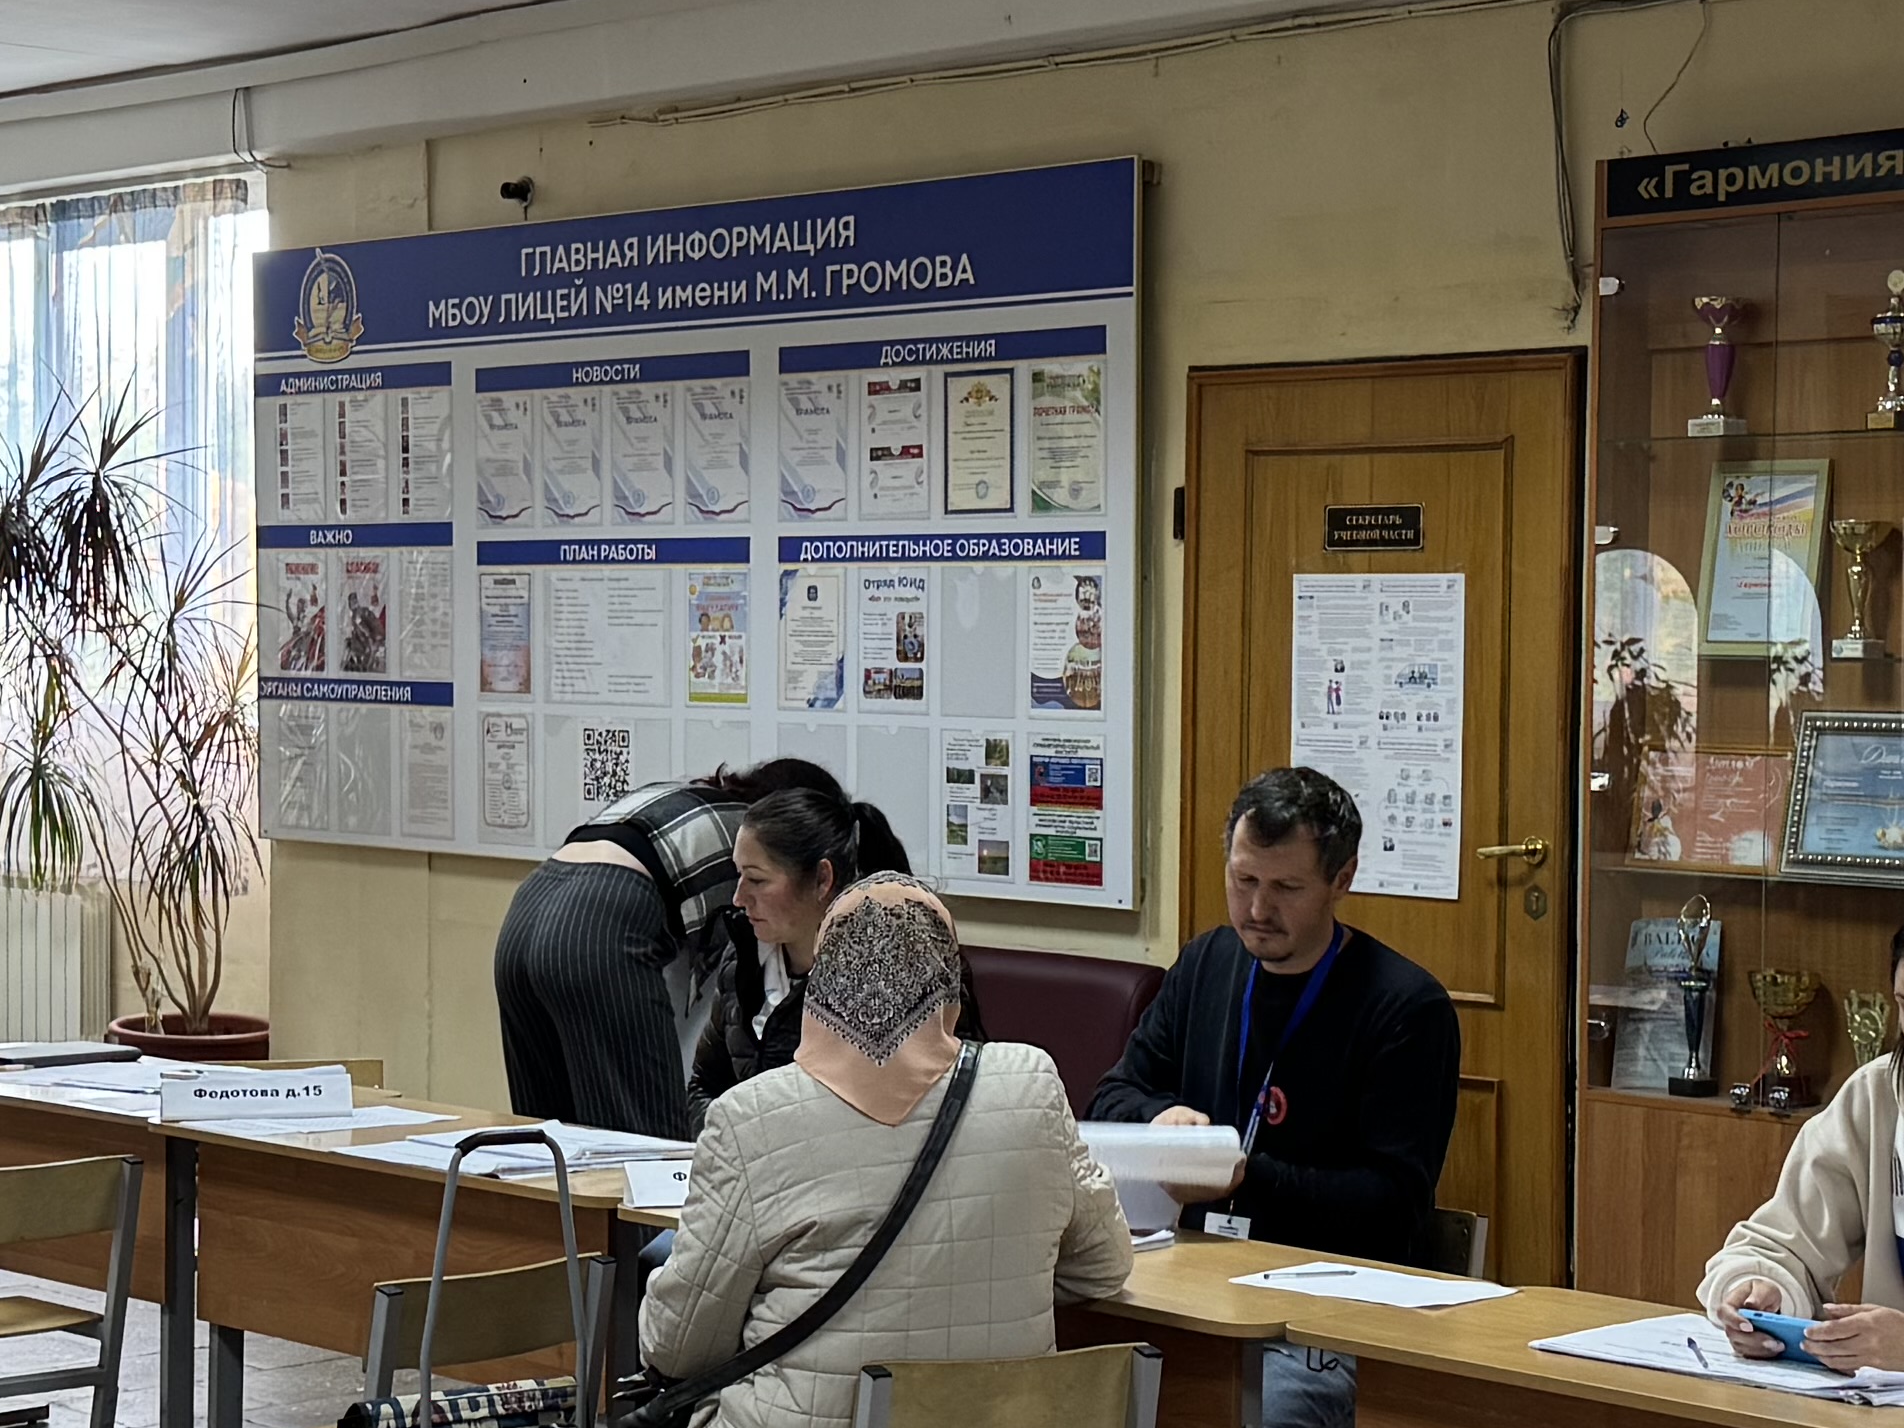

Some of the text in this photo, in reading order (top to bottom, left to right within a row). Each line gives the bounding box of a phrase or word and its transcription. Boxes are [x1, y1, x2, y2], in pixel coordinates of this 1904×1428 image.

[521, 215, 855, 277] ГЛАВНАЯ ИНФОРМАЦИЯ
[428, 253, 975, 328] МБОУ ЛИЦЕЙ №14 имени М.М. ГРОМОВА
[880, 339, 996, 367] ДОСТИЖЕНИЯ
[280, 372, 382, 394] АДМИНИСТРАЦИЯ
[572, 364, 640, 384] НОВОСТИ
[1346, 514, 1402, 525] СЕКРЕТАРЬ
[310, 529, 353, 545] ВАЖНО
[1382, 529, 1414, 540] ЧАСТИ
[560, 543, 656, 562] ПЛАН РАБОТЫ
[800, 537, 1080, 562] ДОПОЛНИТЕЛЬНОЕ ОБРАЗОВАНИЕ
[260, 681, 411, 702] ОРГАНЫ САМОУПРАВЛЕНИЯ
[285, 1085, 322, 1099] д.15
